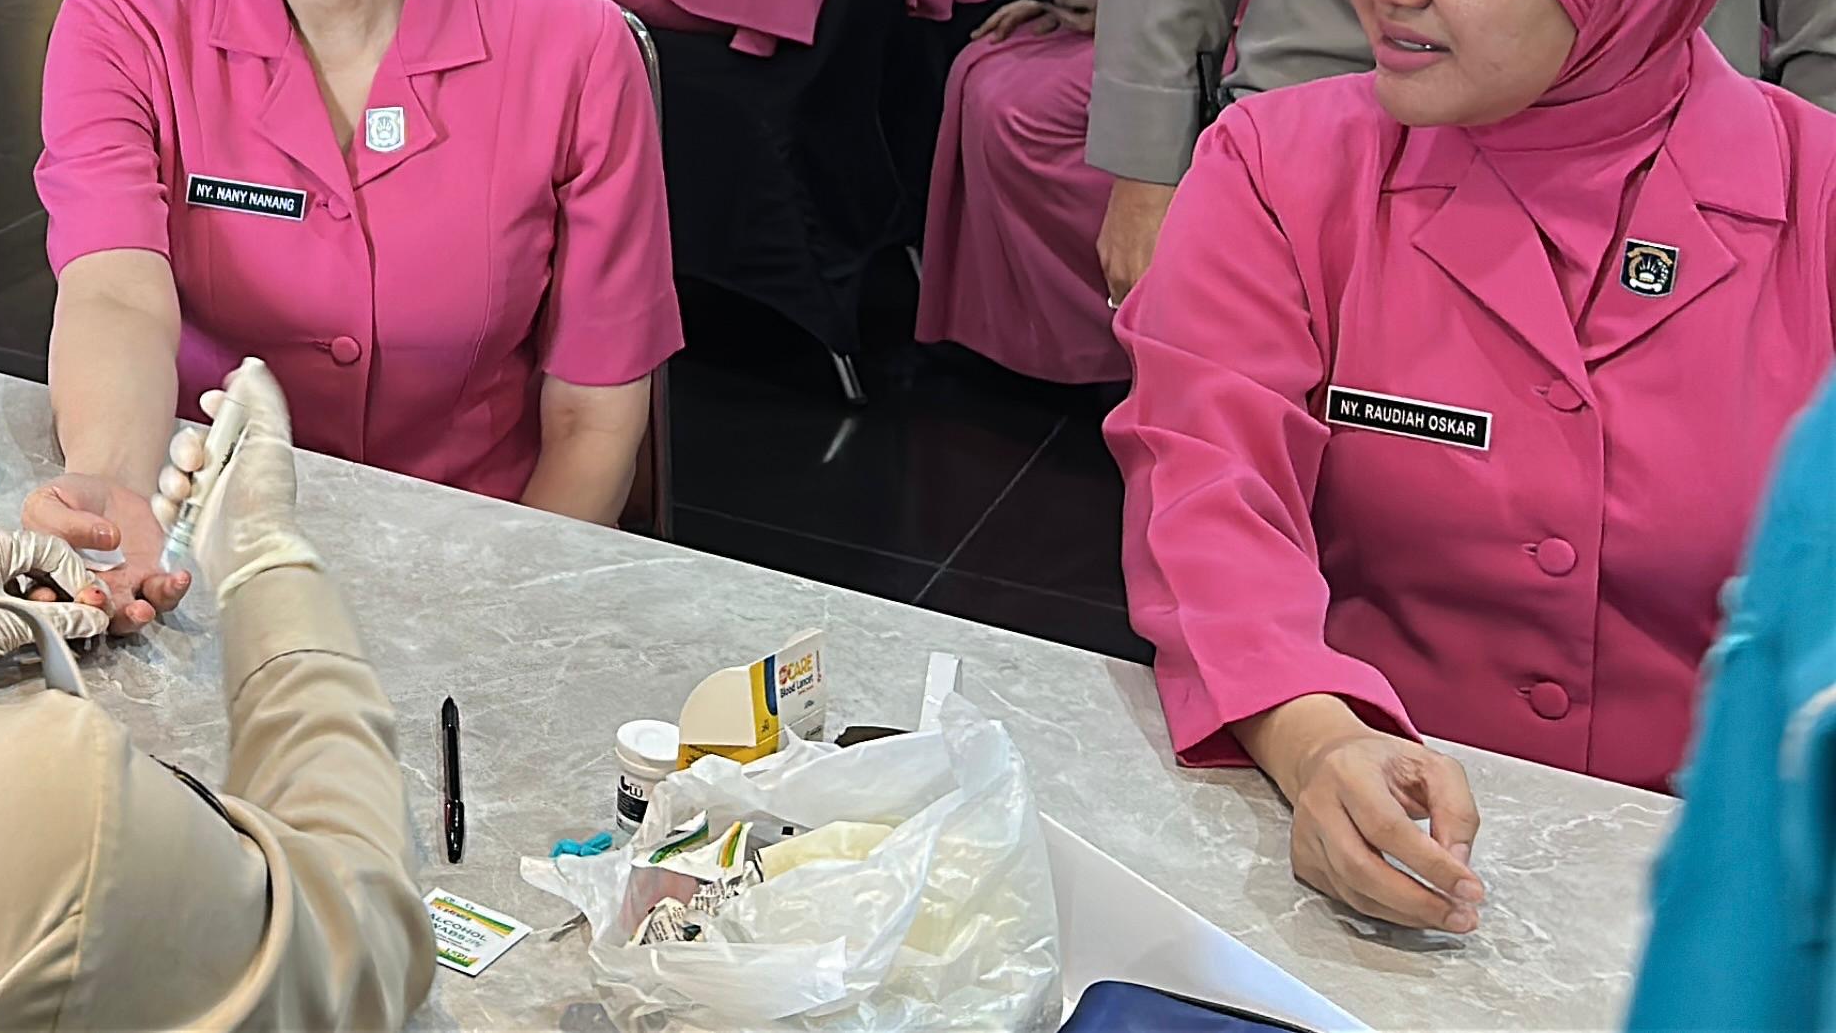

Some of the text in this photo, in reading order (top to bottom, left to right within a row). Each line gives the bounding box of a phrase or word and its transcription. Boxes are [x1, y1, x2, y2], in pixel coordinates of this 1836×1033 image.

[196, 184, 295, 212] NY. NANY NANANG
[1340, 399, 1476, 438] NY. RAUDIAH OSKAR
[430, 913, 488, 942] ALCOHOL
